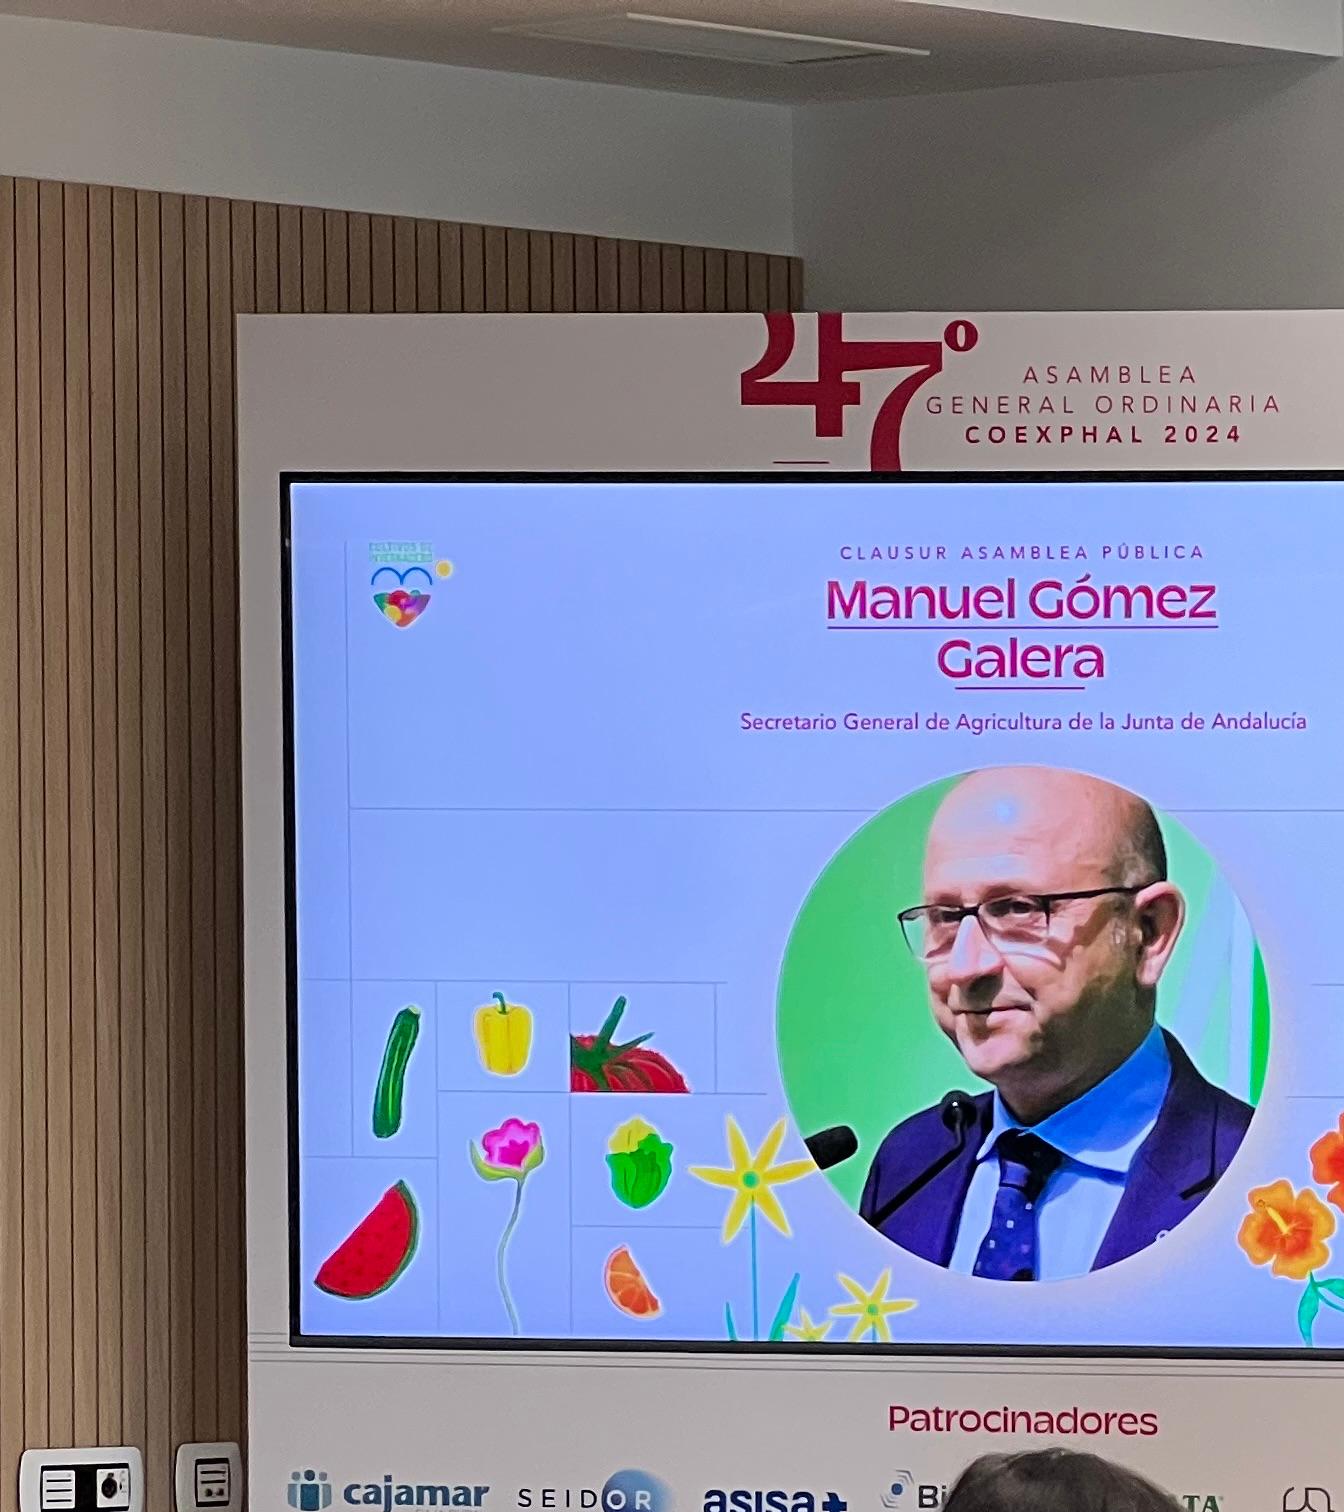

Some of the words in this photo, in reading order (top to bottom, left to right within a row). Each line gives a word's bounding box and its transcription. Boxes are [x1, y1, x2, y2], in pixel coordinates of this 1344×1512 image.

[1023, 365, 1198, 385] ASAMBLEA
[926, 395, 1075, 416] GENERAL
[1096, 394, 1280, 415] ORDINARIA
[965, 425, 1144, 445] COEXPHAL
[1164, 424, 1241, 444] 2024
[840, 546, 948, 561] CLAUSUR
[961, 546, 1088, 560] ASAMBLEA
[1102, 542, 1204, 560] PÚBLICA
[827, 577, 1016, 620] Manuel
[1028, 573, 1217, 619] Gómez
[937, 637, 1105, 679] Galera
[741, 712, 837, 731] Secretario
[843, 712, 919, 731] General
[926, 712, 950, 731] de
[956, 712, 1062, 736] Agricultura
[1068, 713, 1093, 731] de
[1100, 713, 1115, 731] la
[1121, 713, 1174, 731] Junta
[1181, 713, 1205, 731] de
[1211, 712, 1307, 731] Andalucía
[888, 1405, 1159, 1436] Patrocinadores
[518, 1488, 651, 1511] SEIDOR
